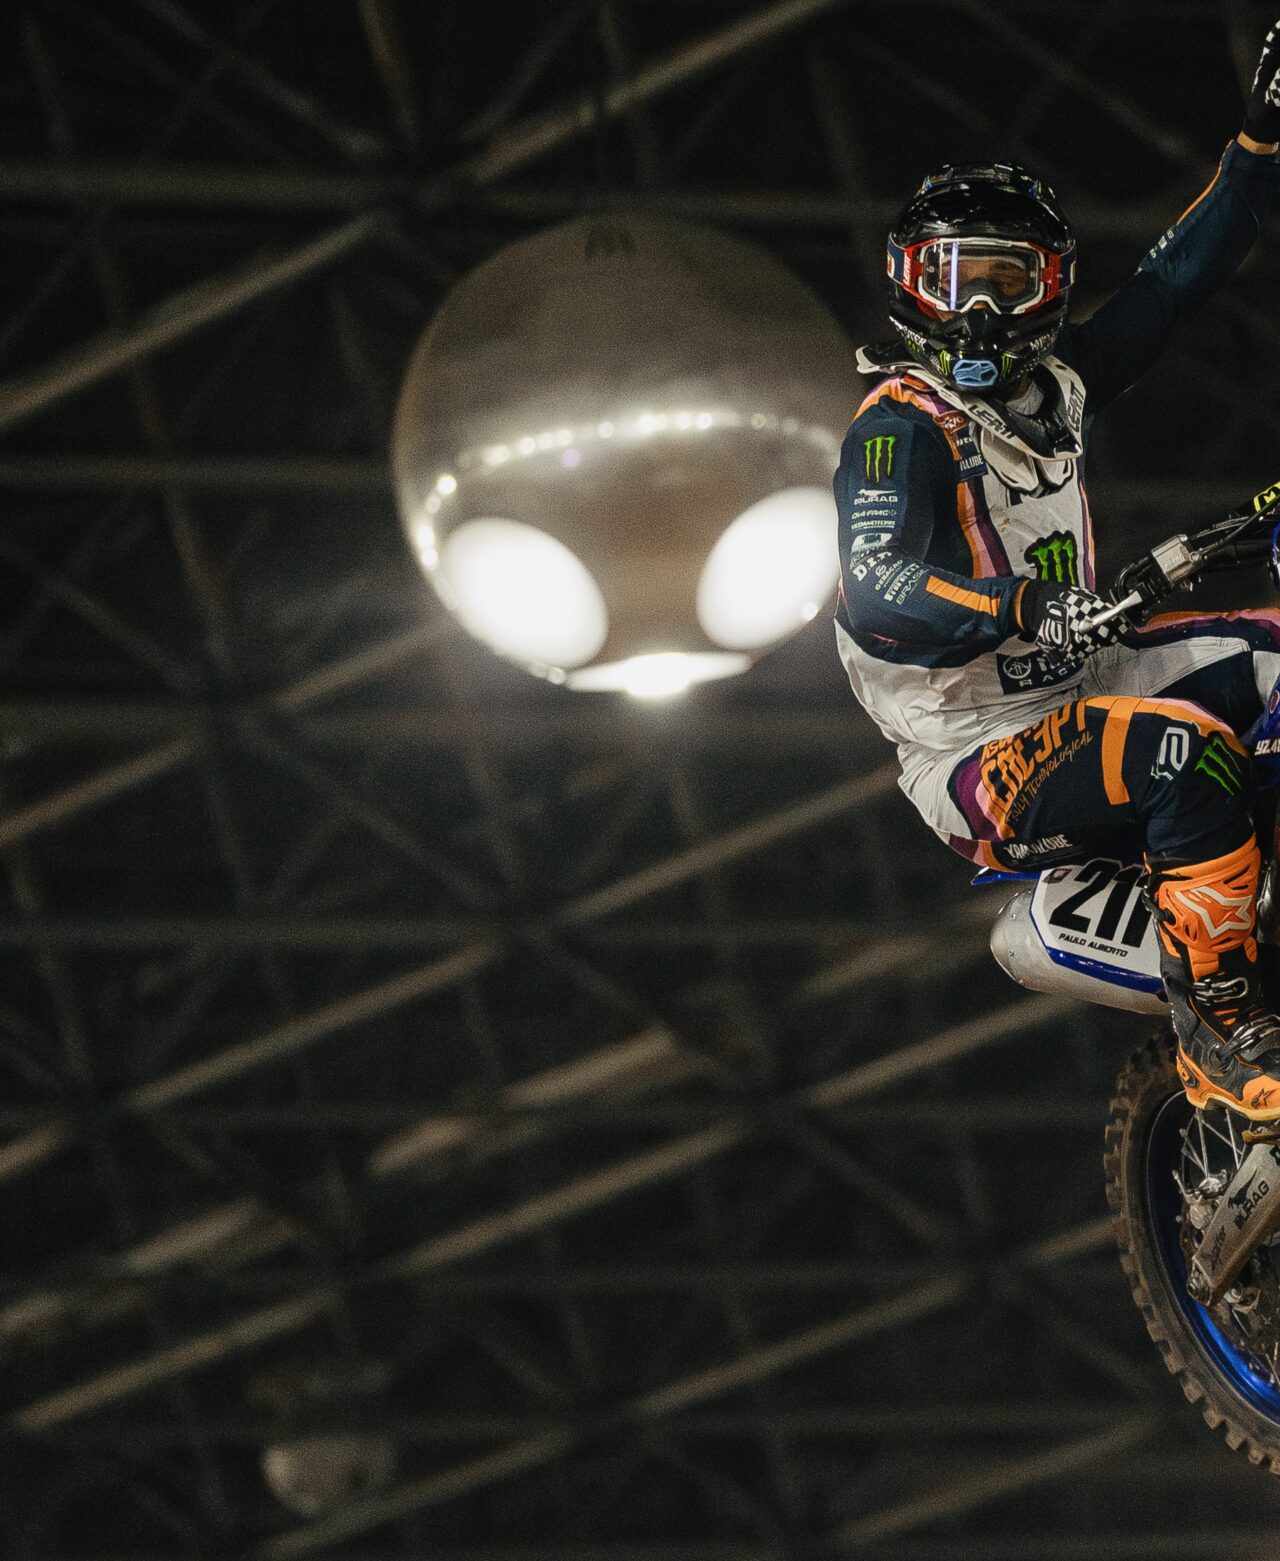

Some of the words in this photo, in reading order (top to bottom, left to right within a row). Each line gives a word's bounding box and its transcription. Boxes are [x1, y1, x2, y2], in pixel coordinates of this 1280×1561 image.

[1048, 859, 1152, 949] 211
[1058, 932, 1087, 947] PAULO
[1087, 940, 1129, 958] ALBERTO
